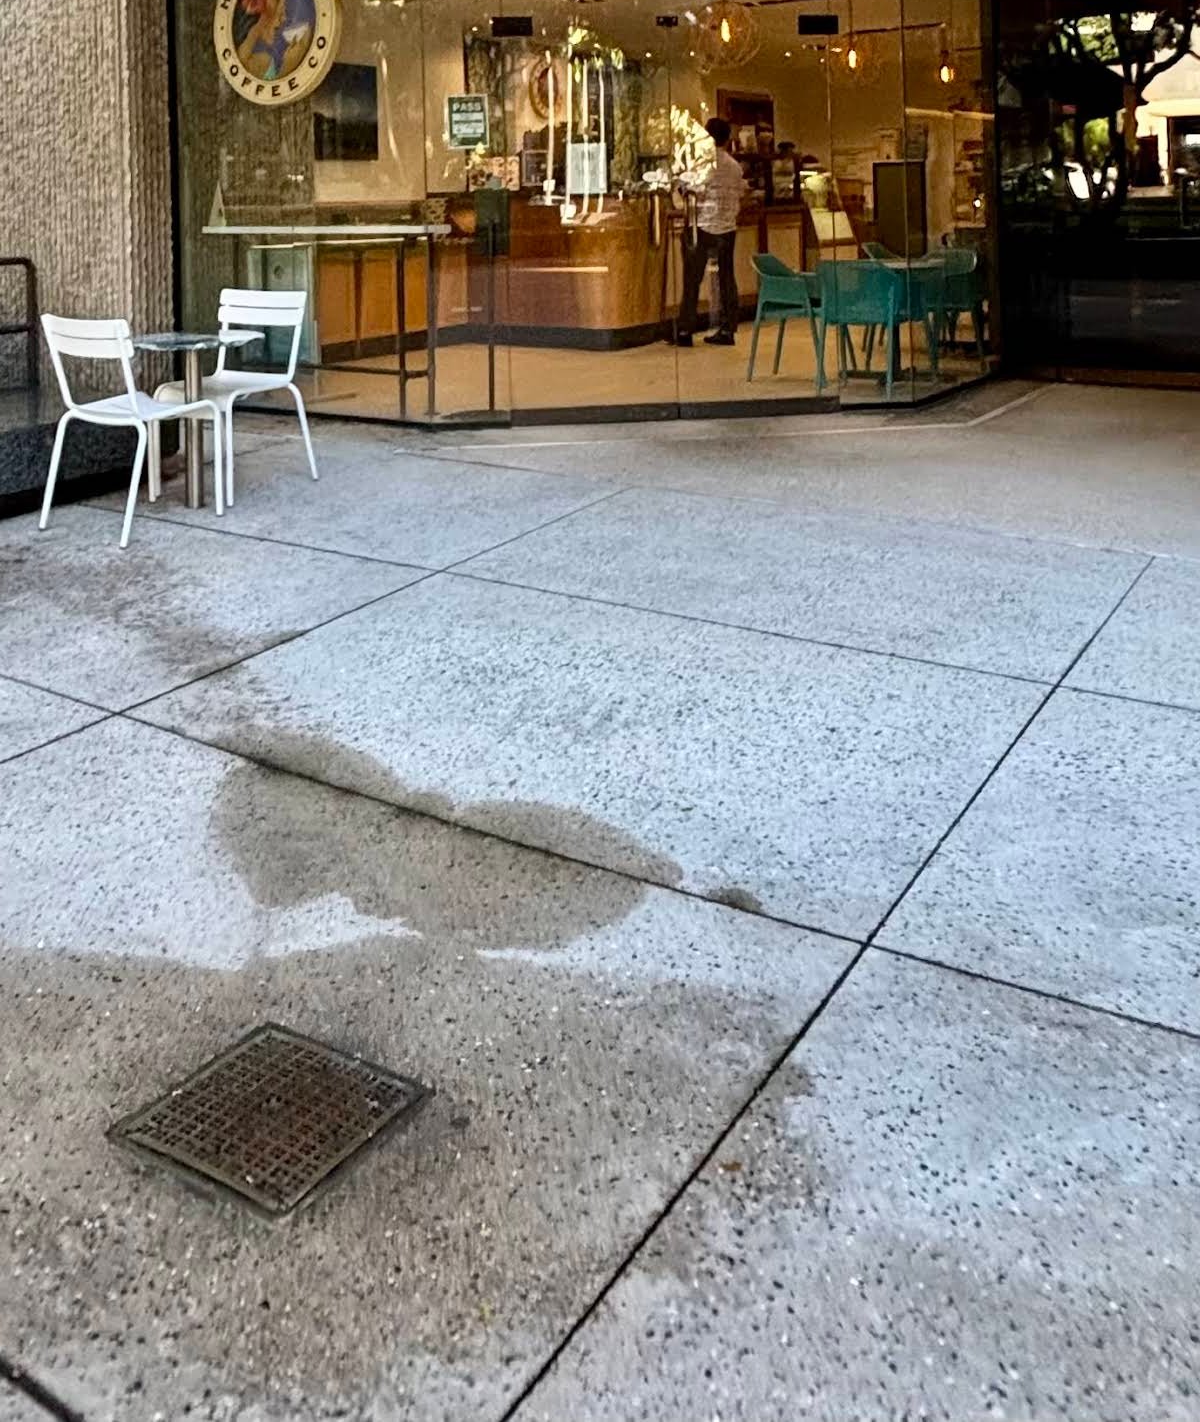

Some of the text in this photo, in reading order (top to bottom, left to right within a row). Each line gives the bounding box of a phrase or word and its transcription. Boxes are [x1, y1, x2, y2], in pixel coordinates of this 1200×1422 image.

[222, 36, 327, 97] COFFEE CO
[452, 102, 482, 112] PASS
